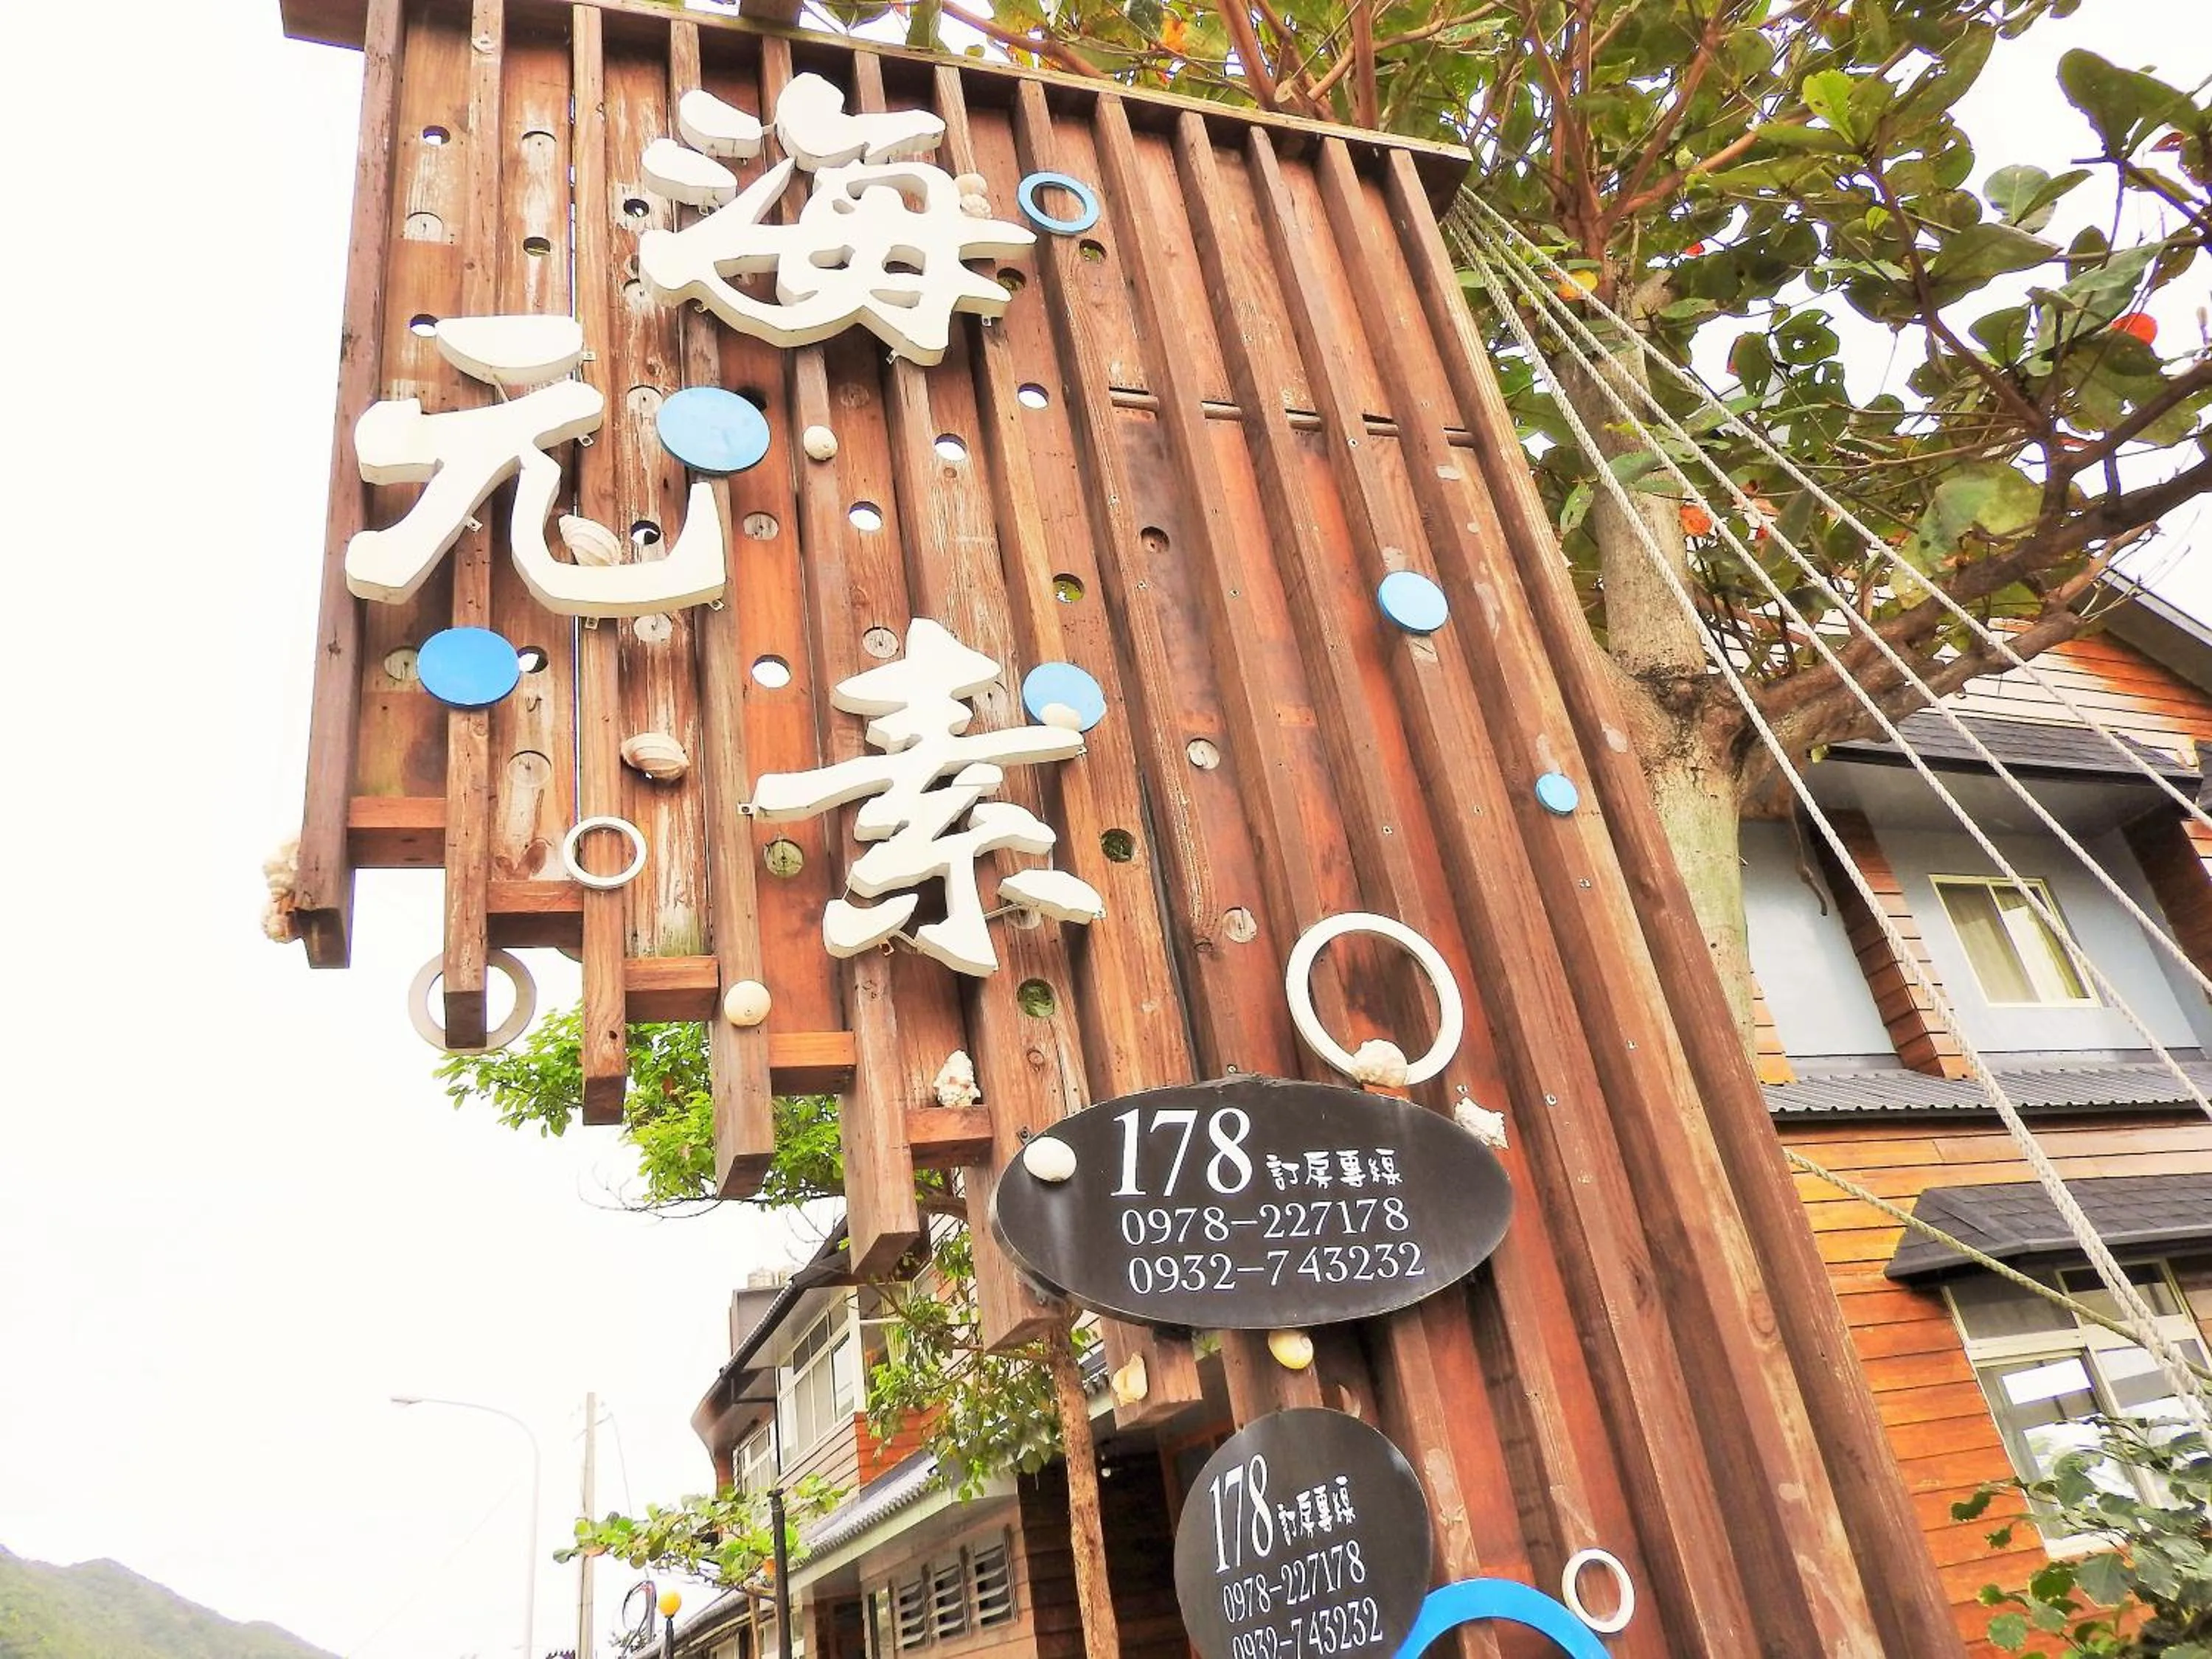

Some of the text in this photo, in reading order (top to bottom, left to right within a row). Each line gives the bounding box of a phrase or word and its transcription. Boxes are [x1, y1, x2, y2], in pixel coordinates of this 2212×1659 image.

[1110, 1107, 1403, 1197] 178 訂房專線
[1121, 1197, 1409, 1245] 0978-227178
[1128, 1241, 1425, 1294] 0932-743232
[1208, 1453, 1356, 1574] 178 訂房專線
[1223, 1540, 1366, 1623] 0978-227178
